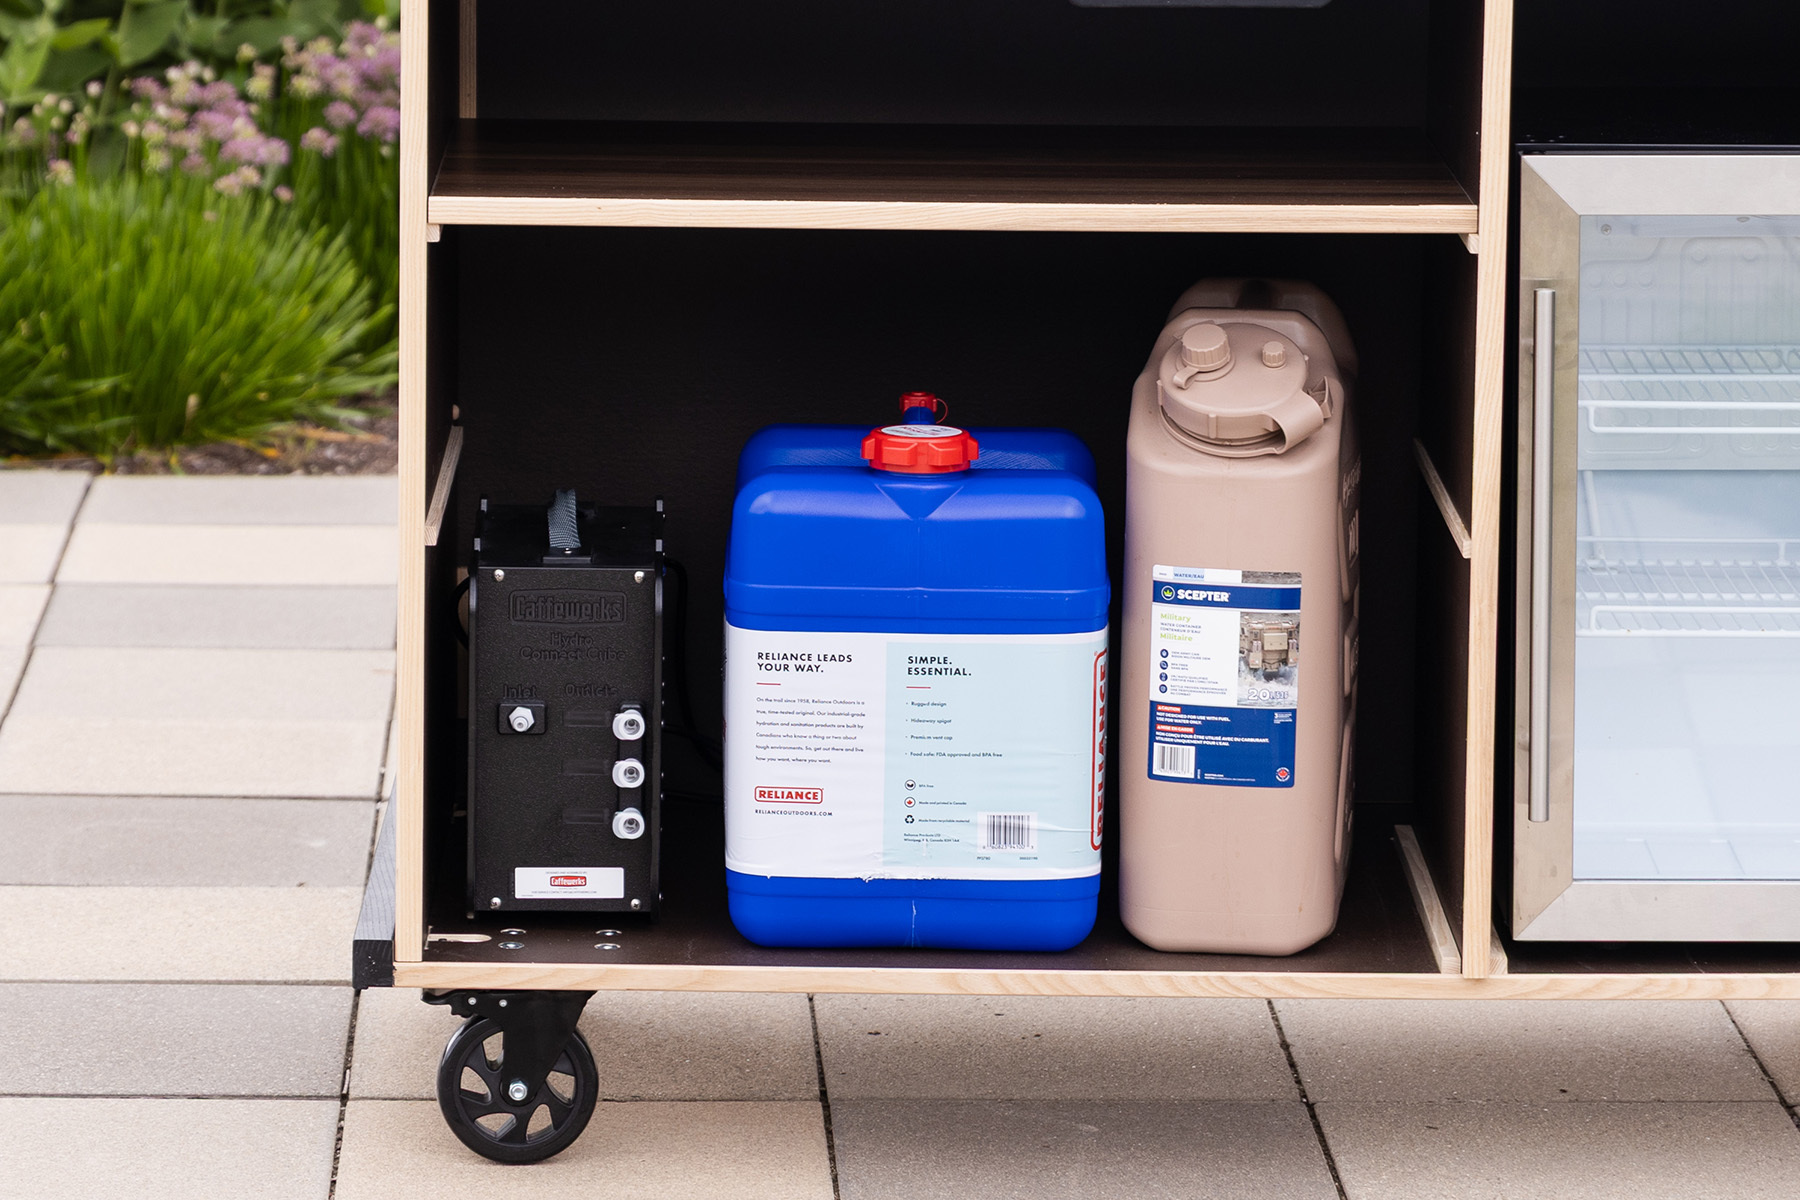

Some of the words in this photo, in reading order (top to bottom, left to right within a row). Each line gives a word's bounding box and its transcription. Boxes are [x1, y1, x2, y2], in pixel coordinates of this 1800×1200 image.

[1177, 589, 1229, 602] SCEPTER
[514, 595, 621, 621] Caffewerks
[1160, 613, 1191, 623] Military
[550, 632, 593, 648] Hydro
[1160, 633, 1193, 641] Militaire
[520, 645, 580, 661] Connect
[587, 647, 625, 660] Cube
[758, 652, 812, 662] RELIANCE
[818, 654, 852, 663] LEADS
[908, 656, 952, 665] SIMPLE.
[757, 663, 790, 672] YOUR
[794, 664, 824, 673] WAY.
[907, 667, 972, 676] ESSENTIAL.
[502, 683, 537, 699] Inlet
[565, 683, 619, 697] Outlets
[758, 790, 819, 800] RELIANCE
[551, 877, 585, 886] Caffewerks
